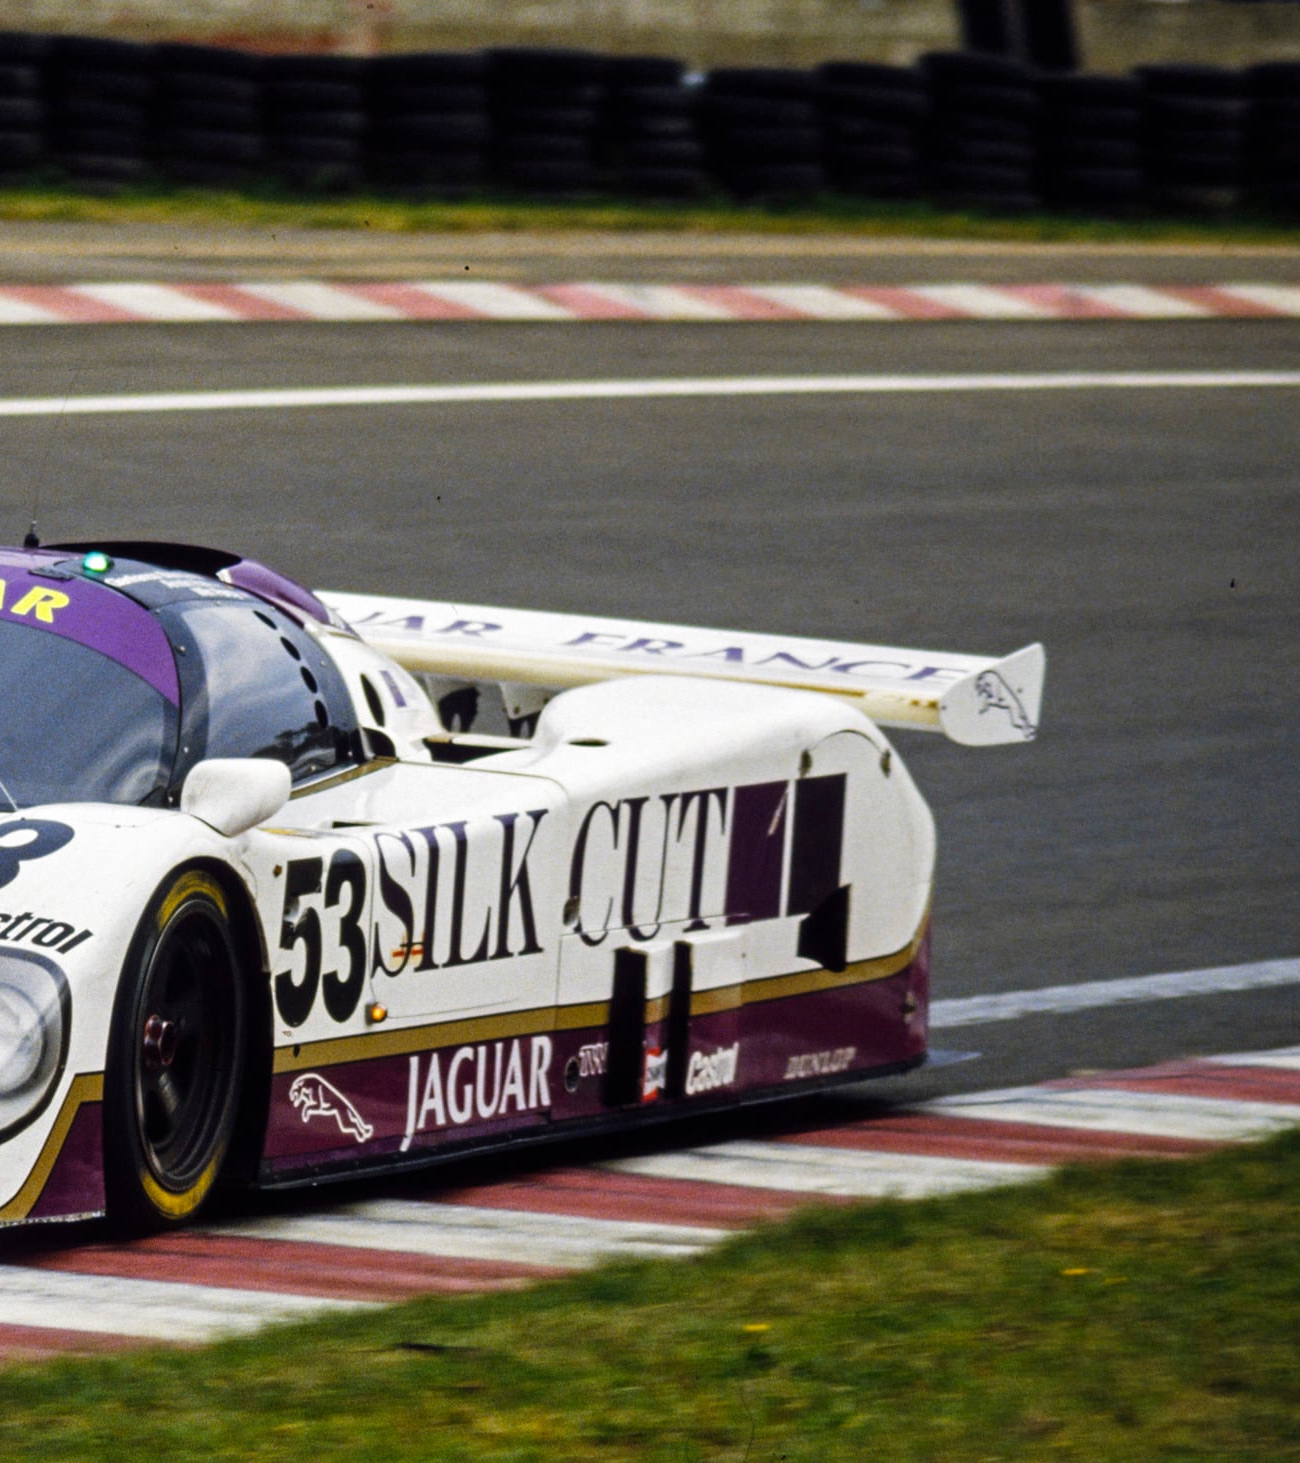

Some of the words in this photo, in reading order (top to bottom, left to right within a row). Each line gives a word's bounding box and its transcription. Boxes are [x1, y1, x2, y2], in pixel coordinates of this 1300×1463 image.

[560, 630, 970, 682] FRANCE
[274, 849, 367, 1028] 53
[371, 808, 550, 977] SILK
[564, 787, 728, 947] CUT
[402, 1035, 553, 1151] JAGUAR
[685, 1041, 740, 1096] Castrol
